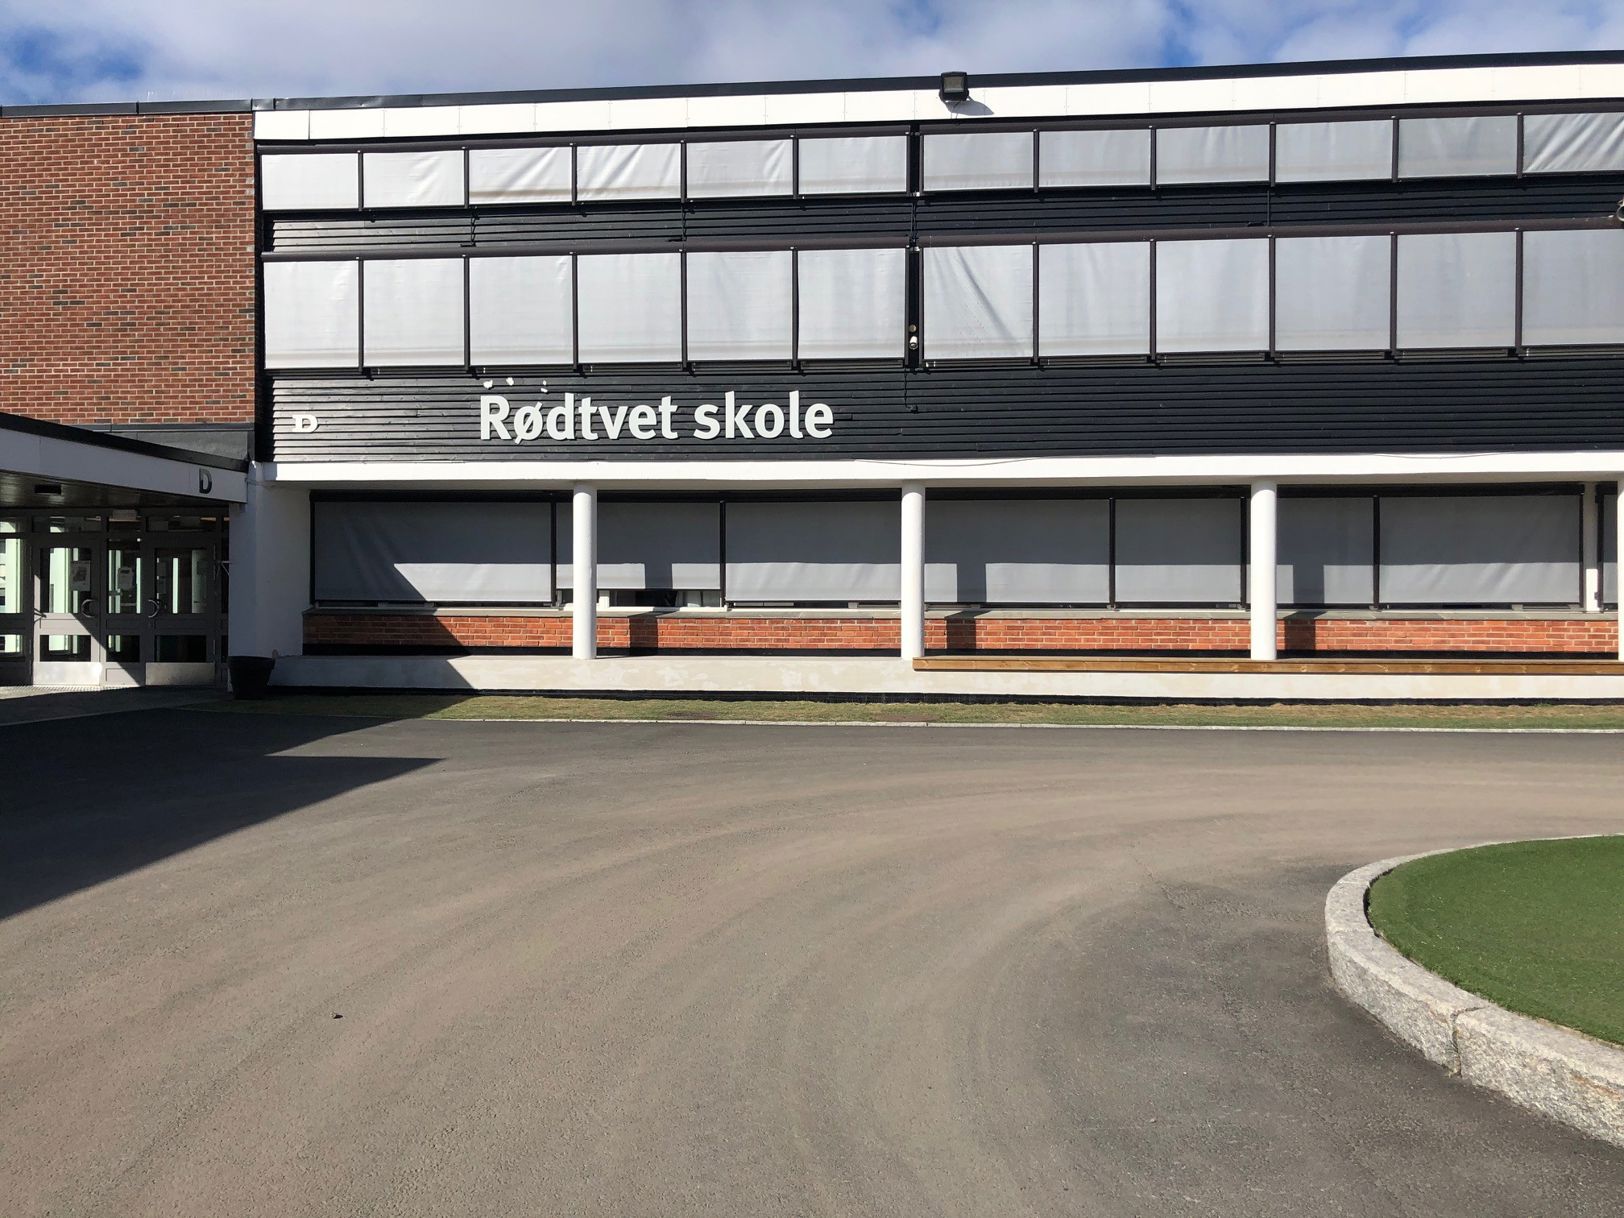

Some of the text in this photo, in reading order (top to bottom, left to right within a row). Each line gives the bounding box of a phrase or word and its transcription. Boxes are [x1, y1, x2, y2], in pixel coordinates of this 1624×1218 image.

[292, 414, 318, 433] D
[480, 390, 834, 444] Rødtvet skole
[199, 468, 213, 495] D
